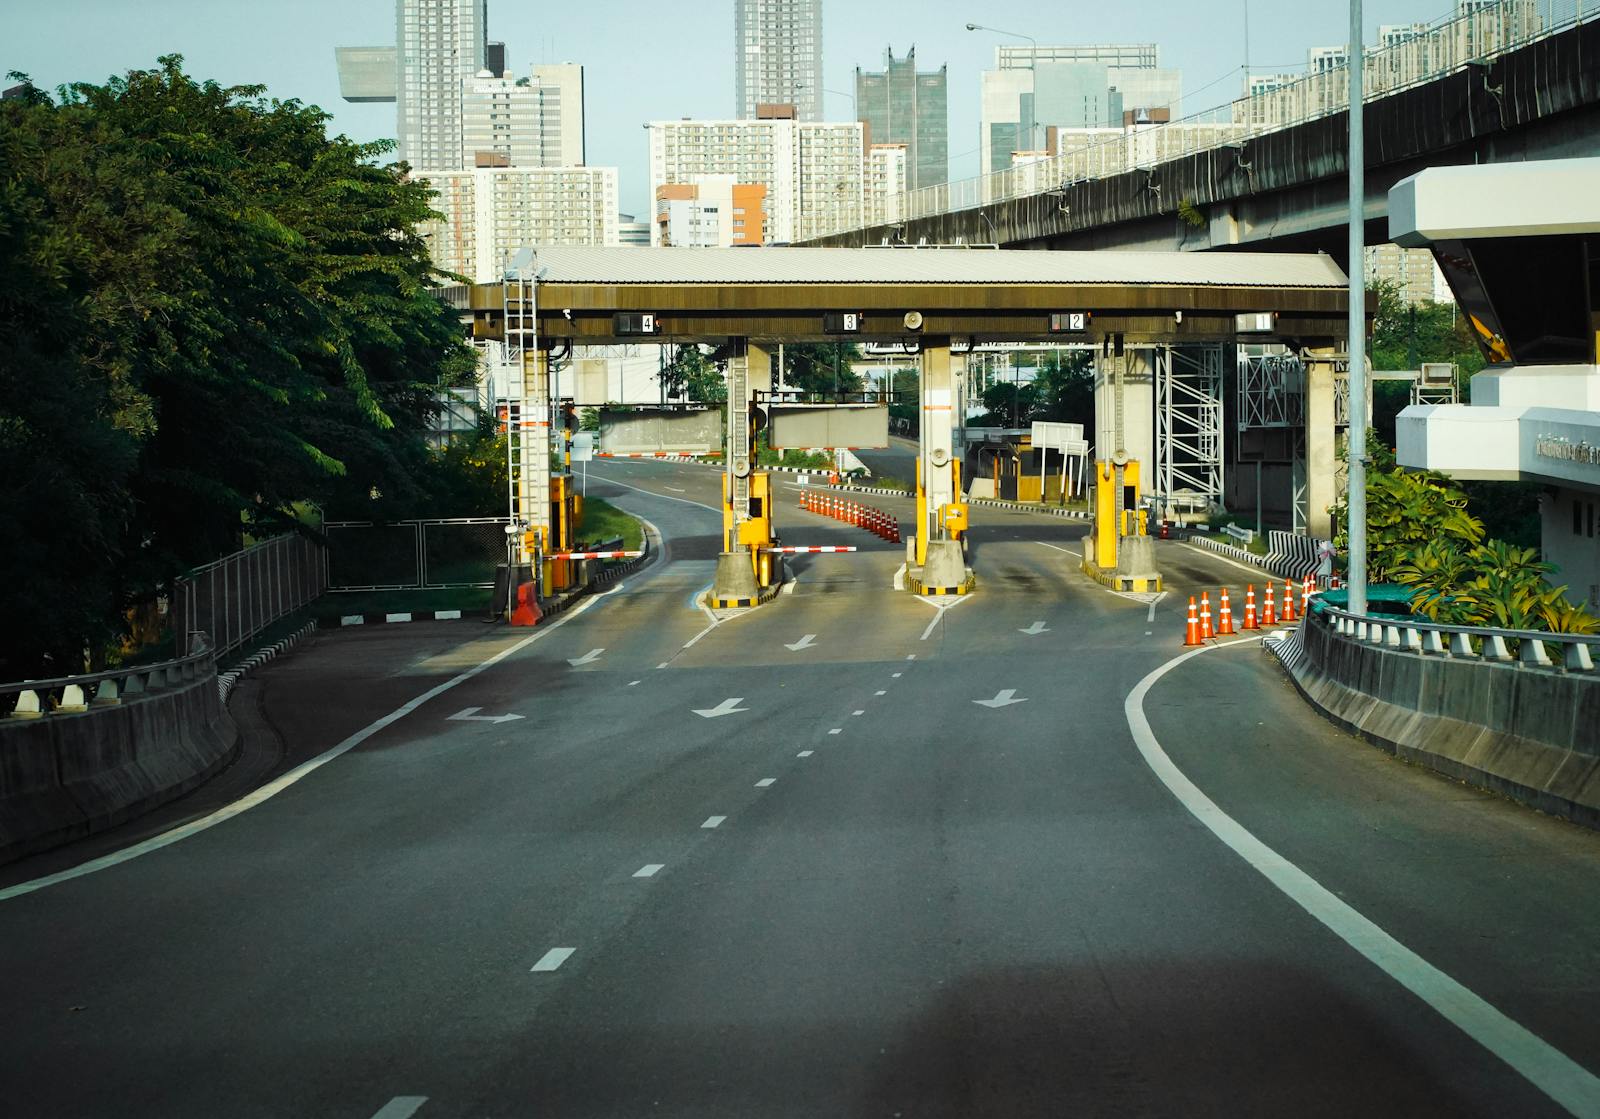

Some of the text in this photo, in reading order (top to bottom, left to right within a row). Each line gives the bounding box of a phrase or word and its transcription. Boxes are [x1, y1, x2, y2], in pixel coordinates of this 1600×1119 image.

[644, 317, 651, 330] 4
[846, 315, 853, 329] 3
[1073, 314, 1080, 329] 2
